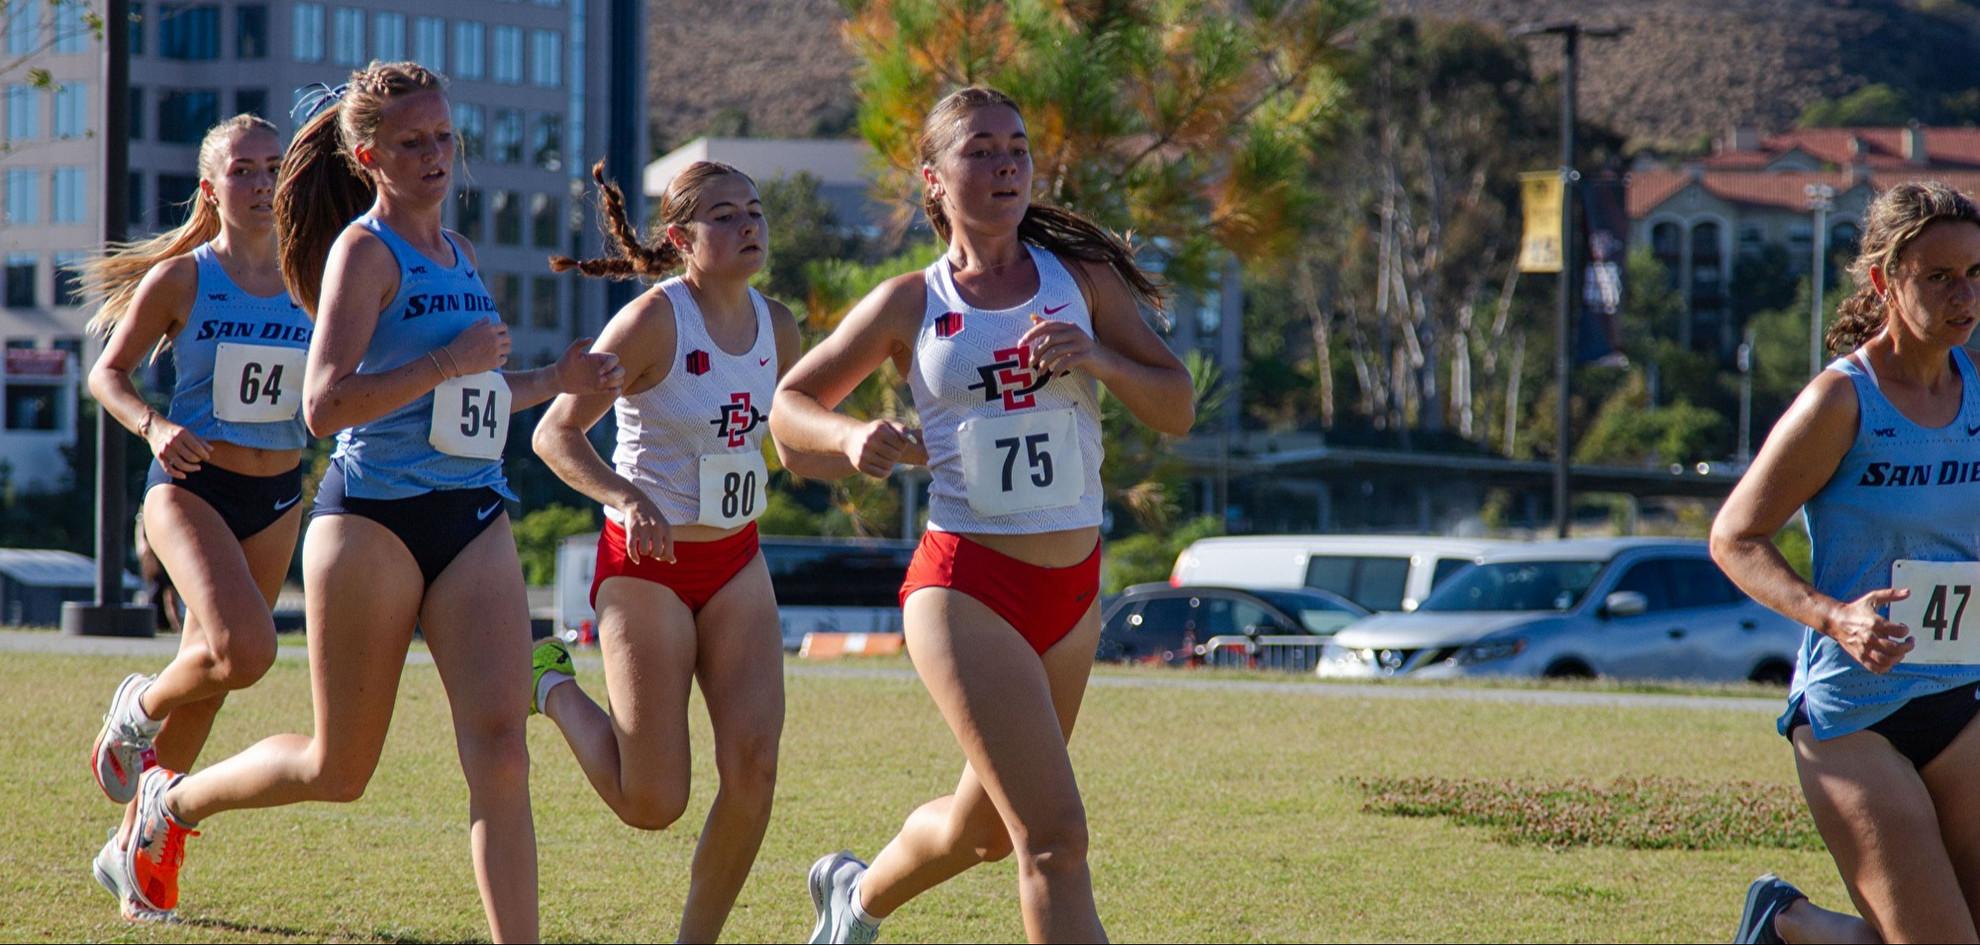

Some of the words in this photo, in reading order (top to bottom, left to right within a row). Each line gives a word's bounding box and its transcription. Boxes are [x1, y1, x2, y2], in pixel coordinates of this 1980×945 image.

[403, 293, 460, 321] SAN
[463, 292, 498, 313] DIE
[196, 320, 256, 341] SAN
[240, 362, 284, 405] 64
[460, 388, 497, 439] 54
[995, 433, 1054, 492] 75
[1858, 462, 1932, 487] SAN
[722, 470, 756, 519] 80
[1922, 585, 1972, 641] 47
